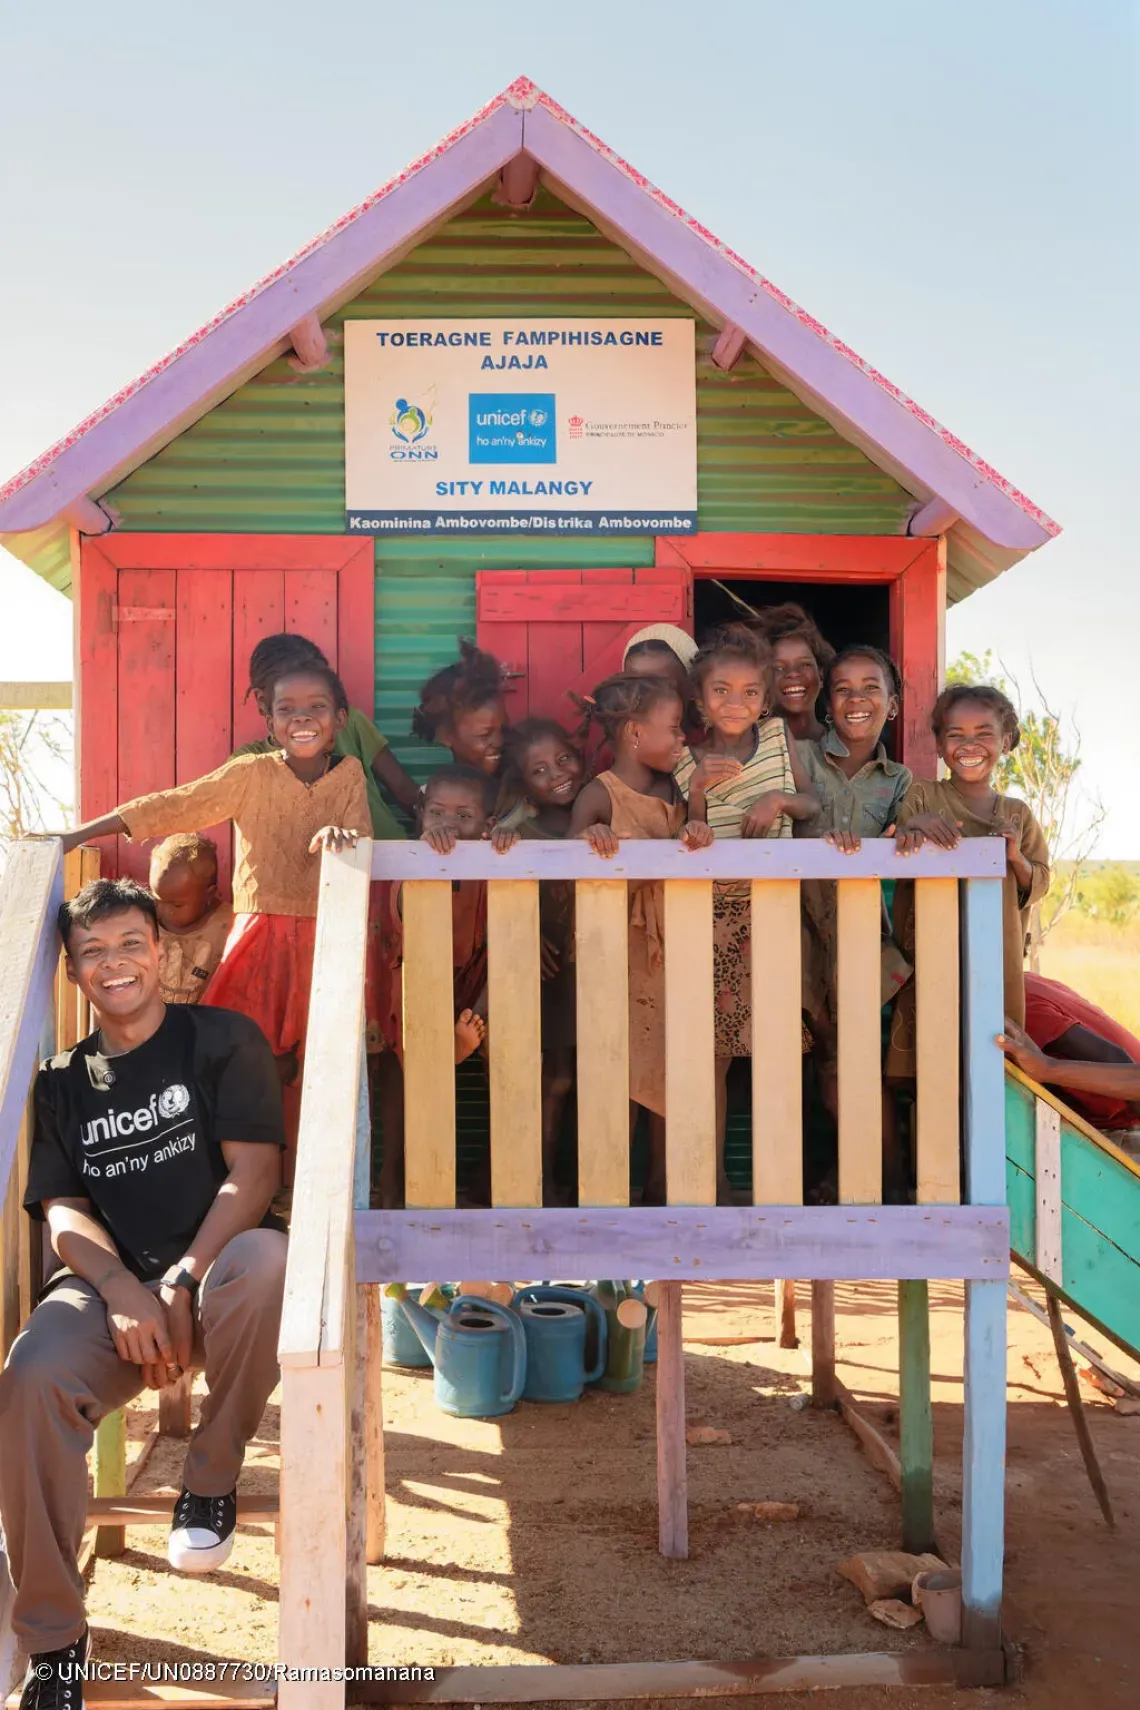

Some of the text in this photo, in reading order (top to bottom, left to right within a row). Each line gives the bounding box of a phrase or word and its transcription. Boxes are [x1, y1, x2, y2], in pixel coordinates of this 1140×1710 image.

[376, 331, 664, 347] TOERAGNE FAMPIHISAGNE
[480, 355, 549, 370] AJAJA
[476, 409, 527, 426] unicef
[476, 435, 490, 446] ho
[390, 451, 438, 459] ONN
[435, 481, 593, 496] SITY MALANGY
[350, 516, 692, 529] Kaominina Ambovombe/Distrika Ambovombe
[80, 1093, 159, 1146] unicef
[82, 1132, 196, 1178] ho an'ny ankizy
